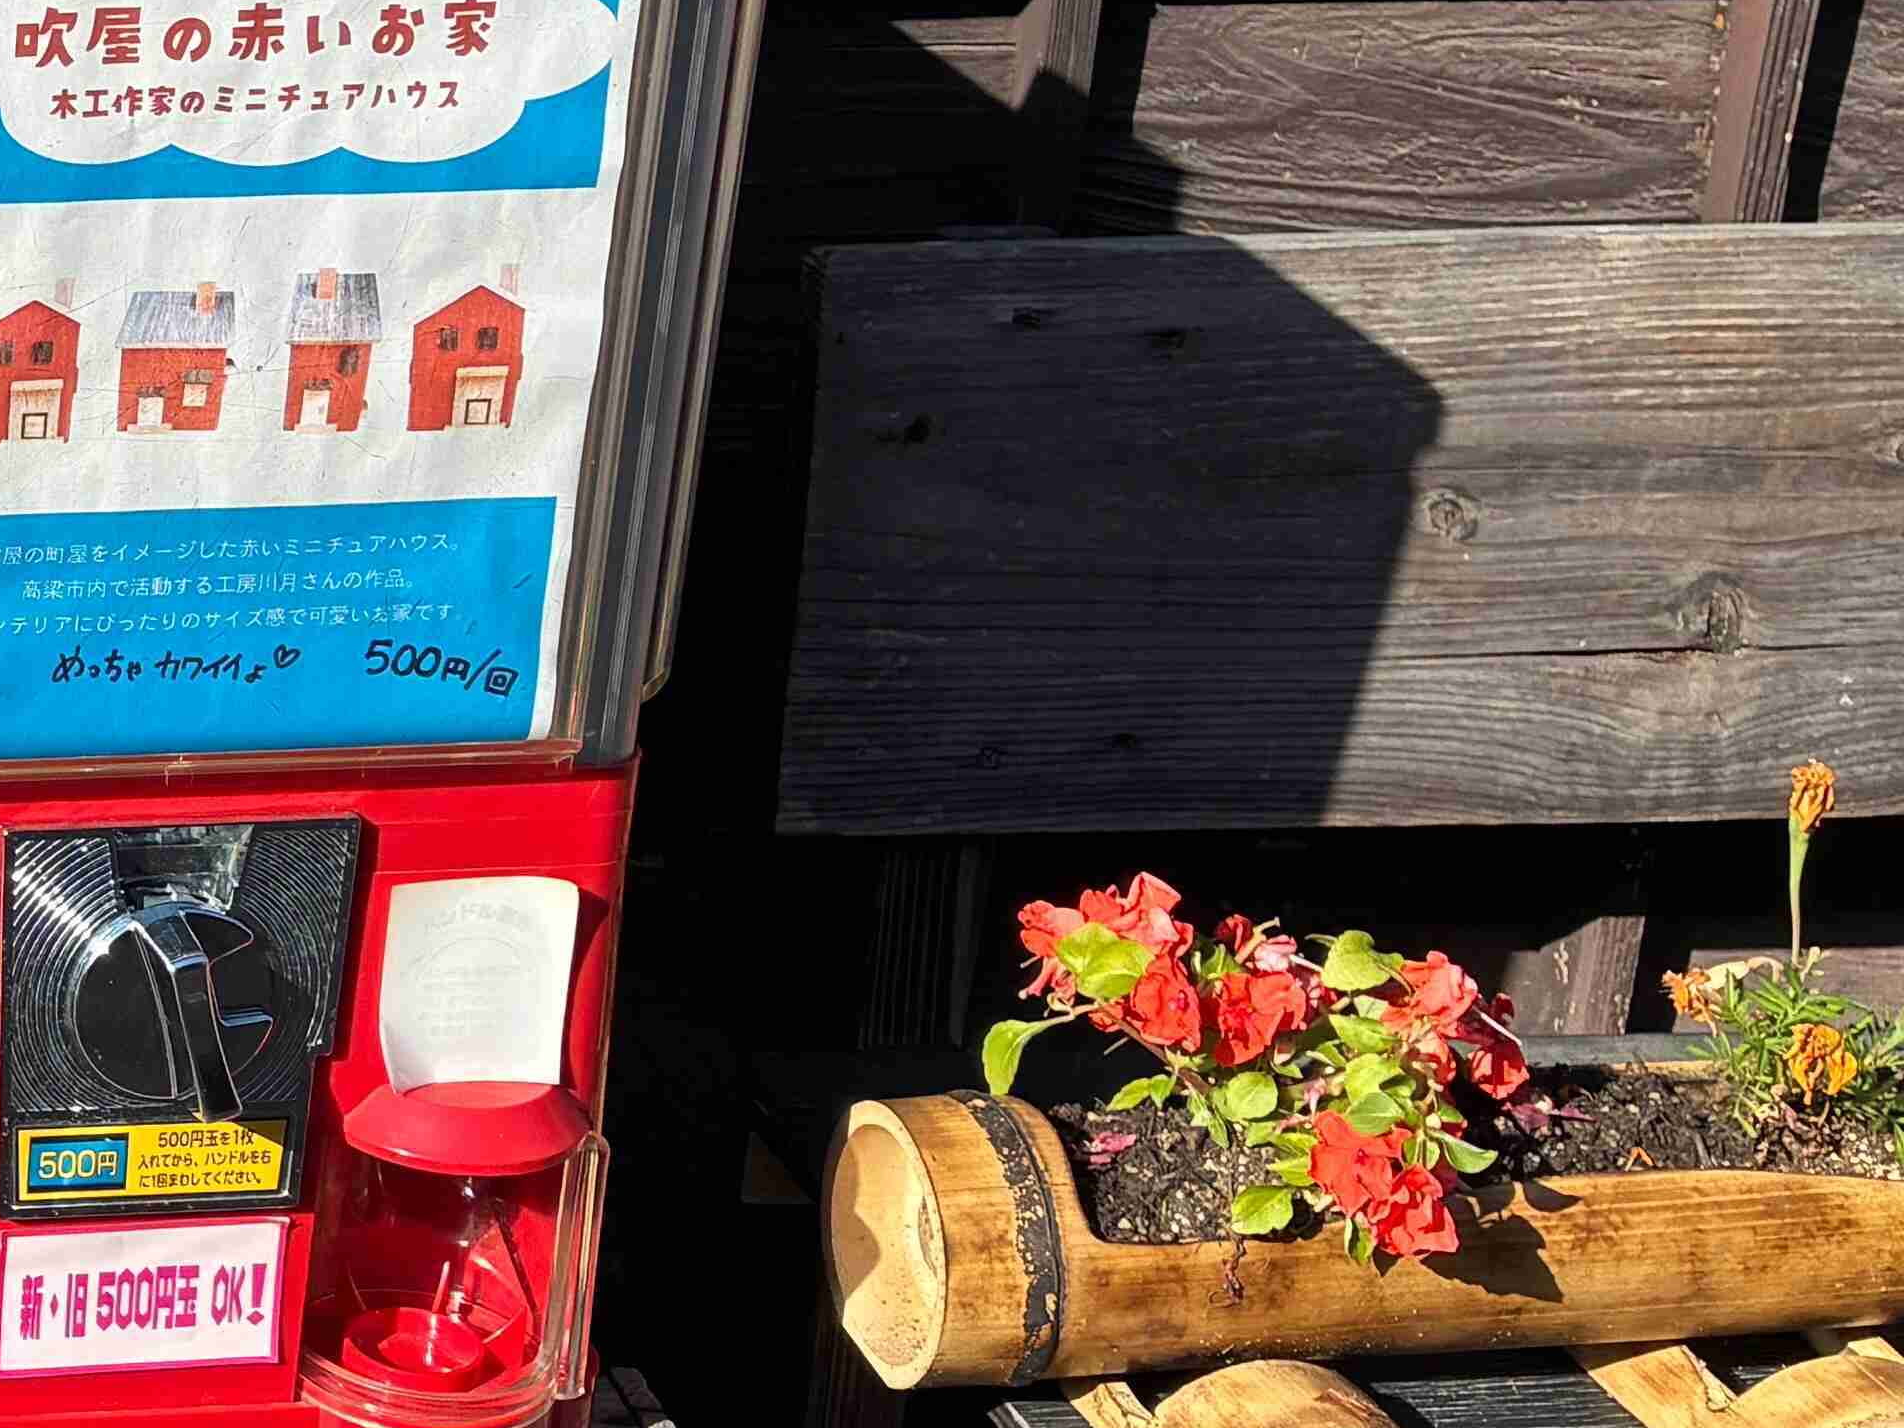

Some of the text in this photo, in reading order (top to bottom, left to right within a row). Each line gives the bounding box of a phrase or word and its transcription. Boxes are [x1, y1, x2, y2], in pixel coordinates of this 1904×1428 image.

[49, 79, 460, 121] 木工作家のミニチュアハウス
[51, 644, 143, 683] めっちゃ
[158, 1128, 255, 1149] 500円玉を1枚
[38, 1149, 119, 1179] 500円
